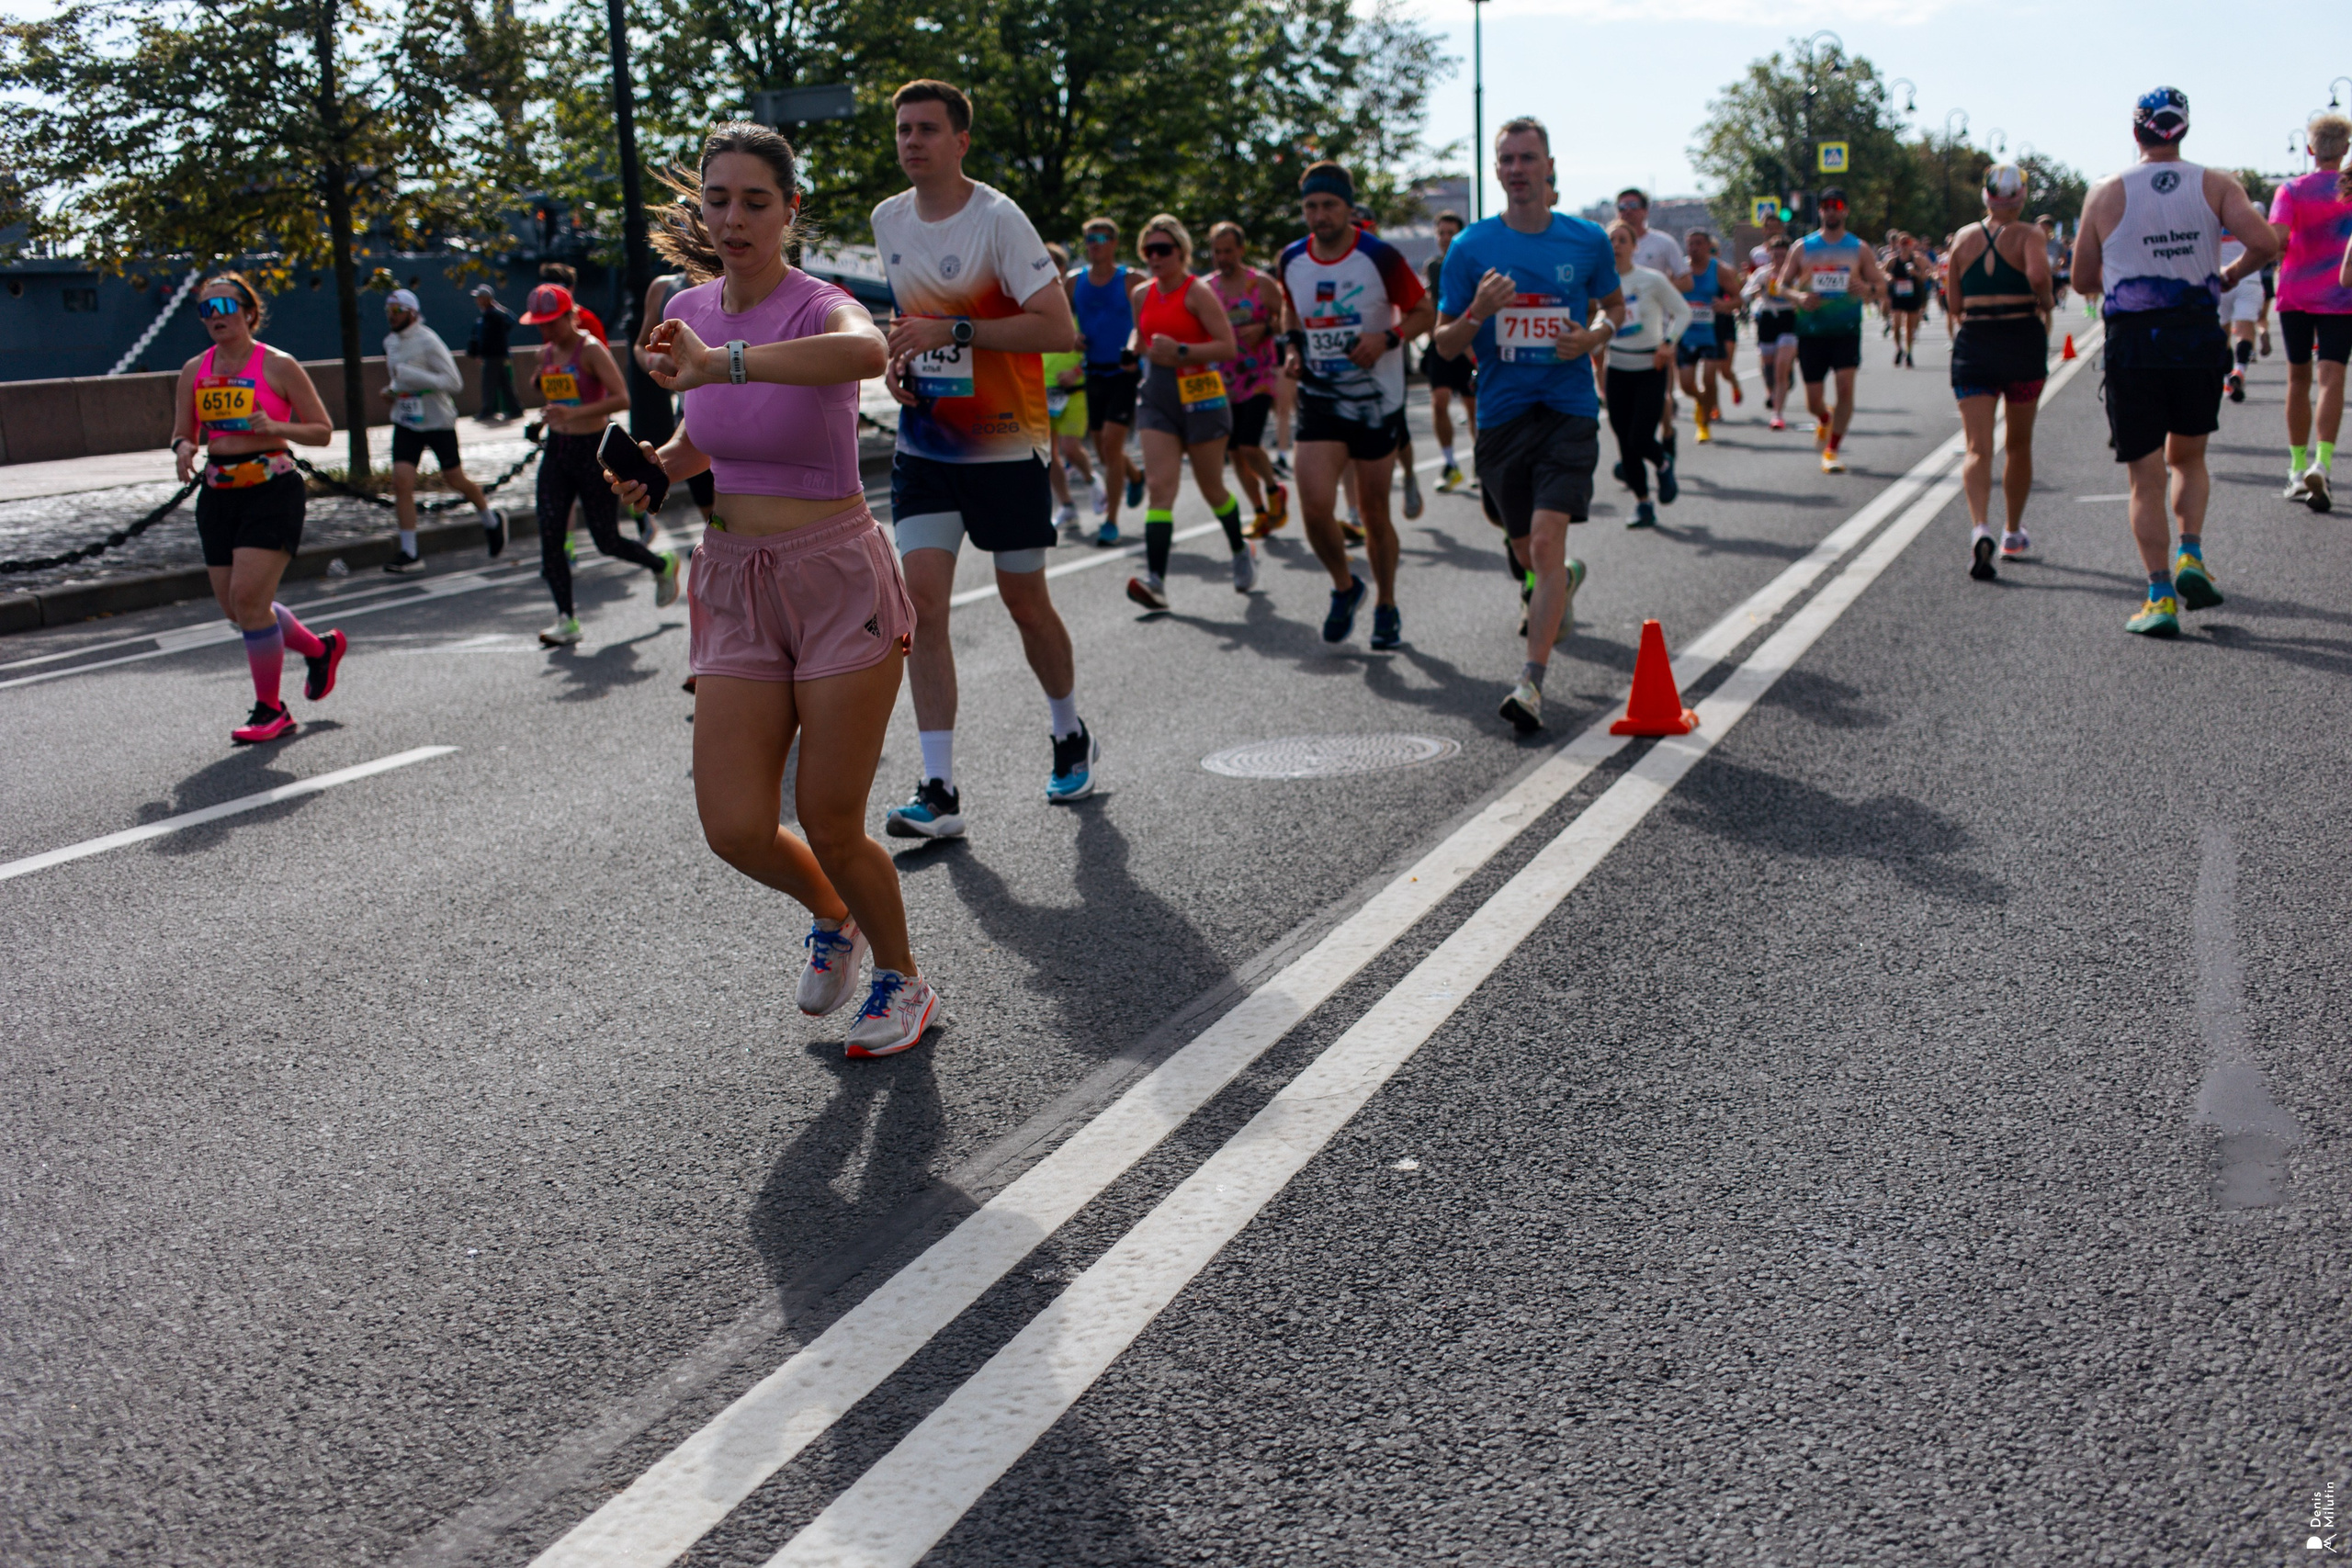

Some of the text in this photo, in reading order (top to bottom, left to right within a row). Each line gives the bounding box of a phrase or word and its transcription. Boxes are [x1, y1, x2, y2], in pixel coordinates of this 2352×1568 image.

[2143, 229, 2200, 245] run beer
[2153, 244, 2195, 260] repeat
[1555, 264, 1574, 282] 10
[1504, 316, 1560, 339] 7155
[912, 347, 961, 364] 143
[203, 391, 244, 411] 6516
[972, 422, 1020, 435] 2026
